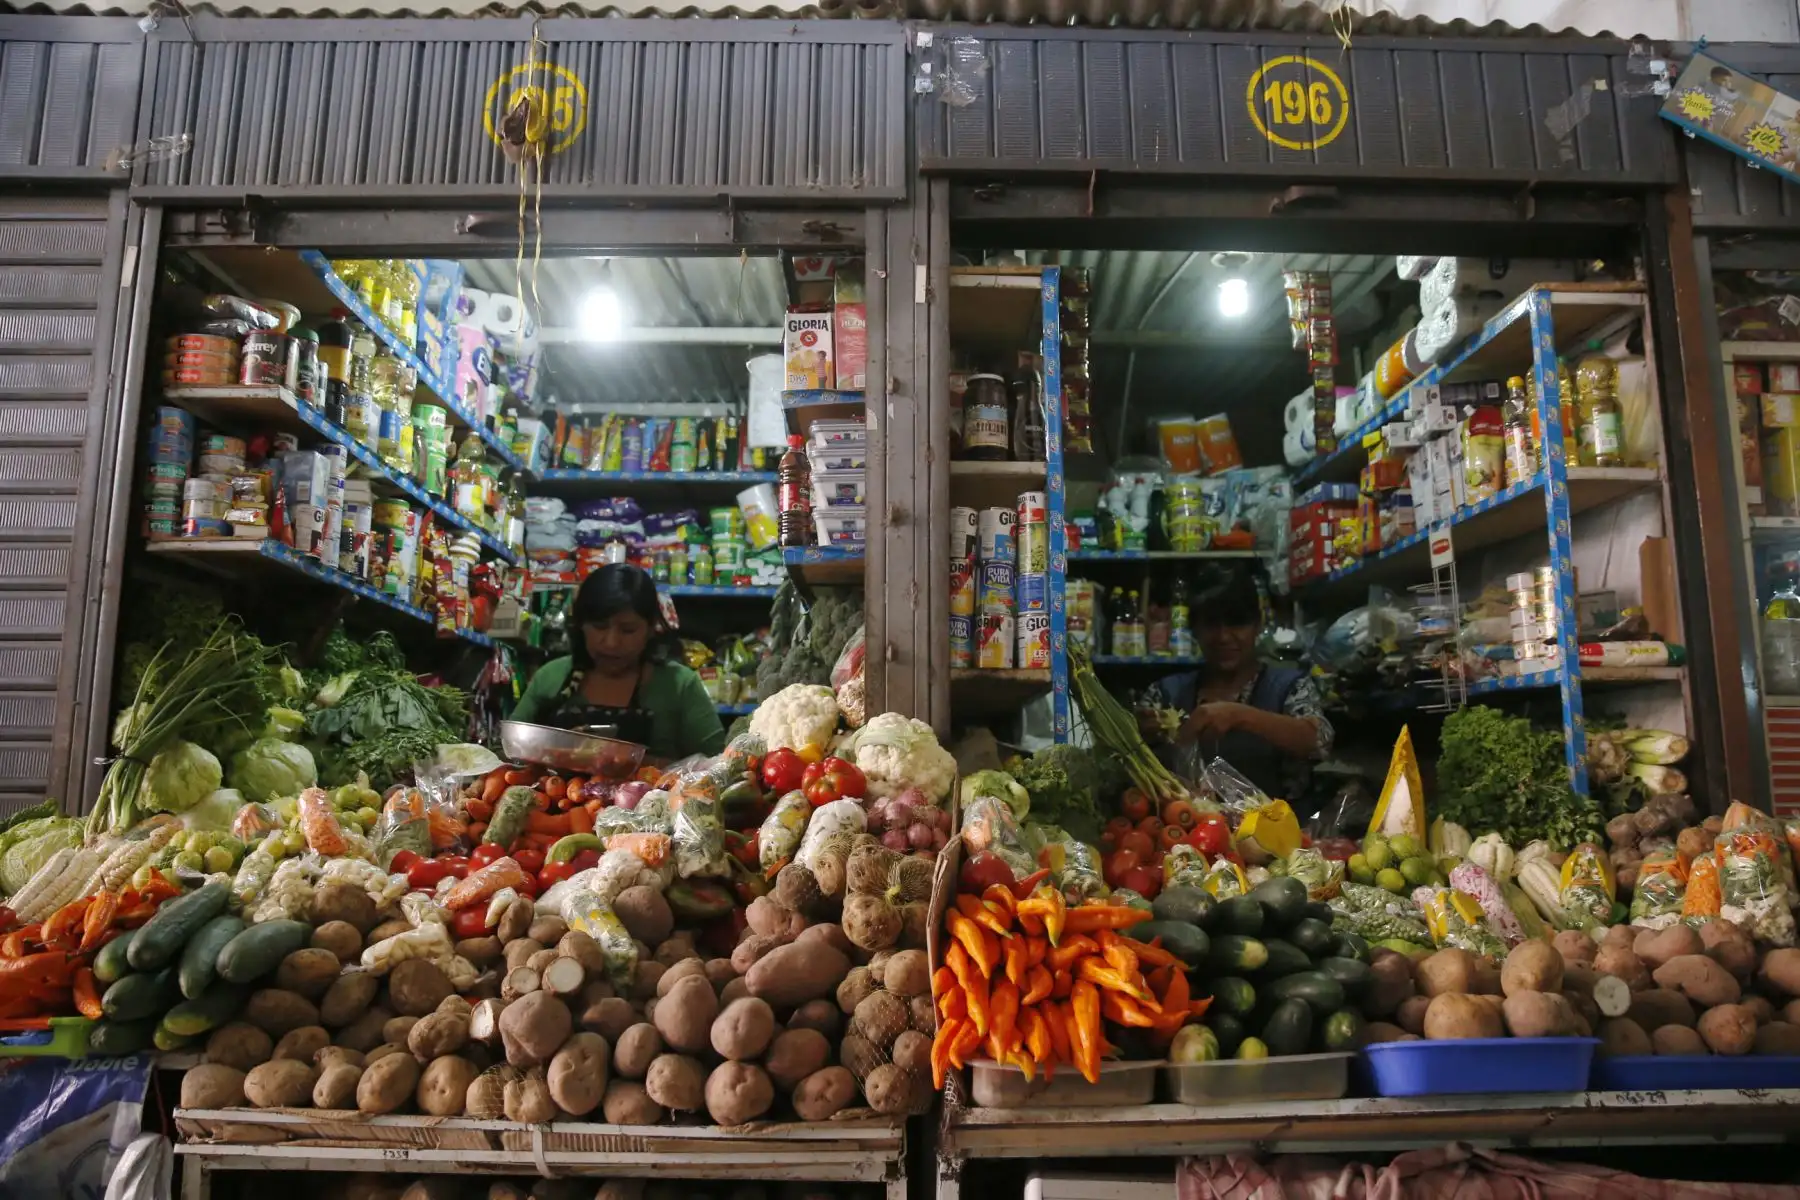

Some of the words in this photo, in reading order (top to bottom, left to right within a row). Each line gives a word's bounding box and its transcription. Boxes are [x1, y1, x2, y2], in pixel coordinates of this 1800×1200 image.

[1264, 80, 1333, 125] 196
[788, 319, 829, 333] GLORIA
[987, 567, 1010, 577] PURA
[990, 574, 1011, 585] VIDA
